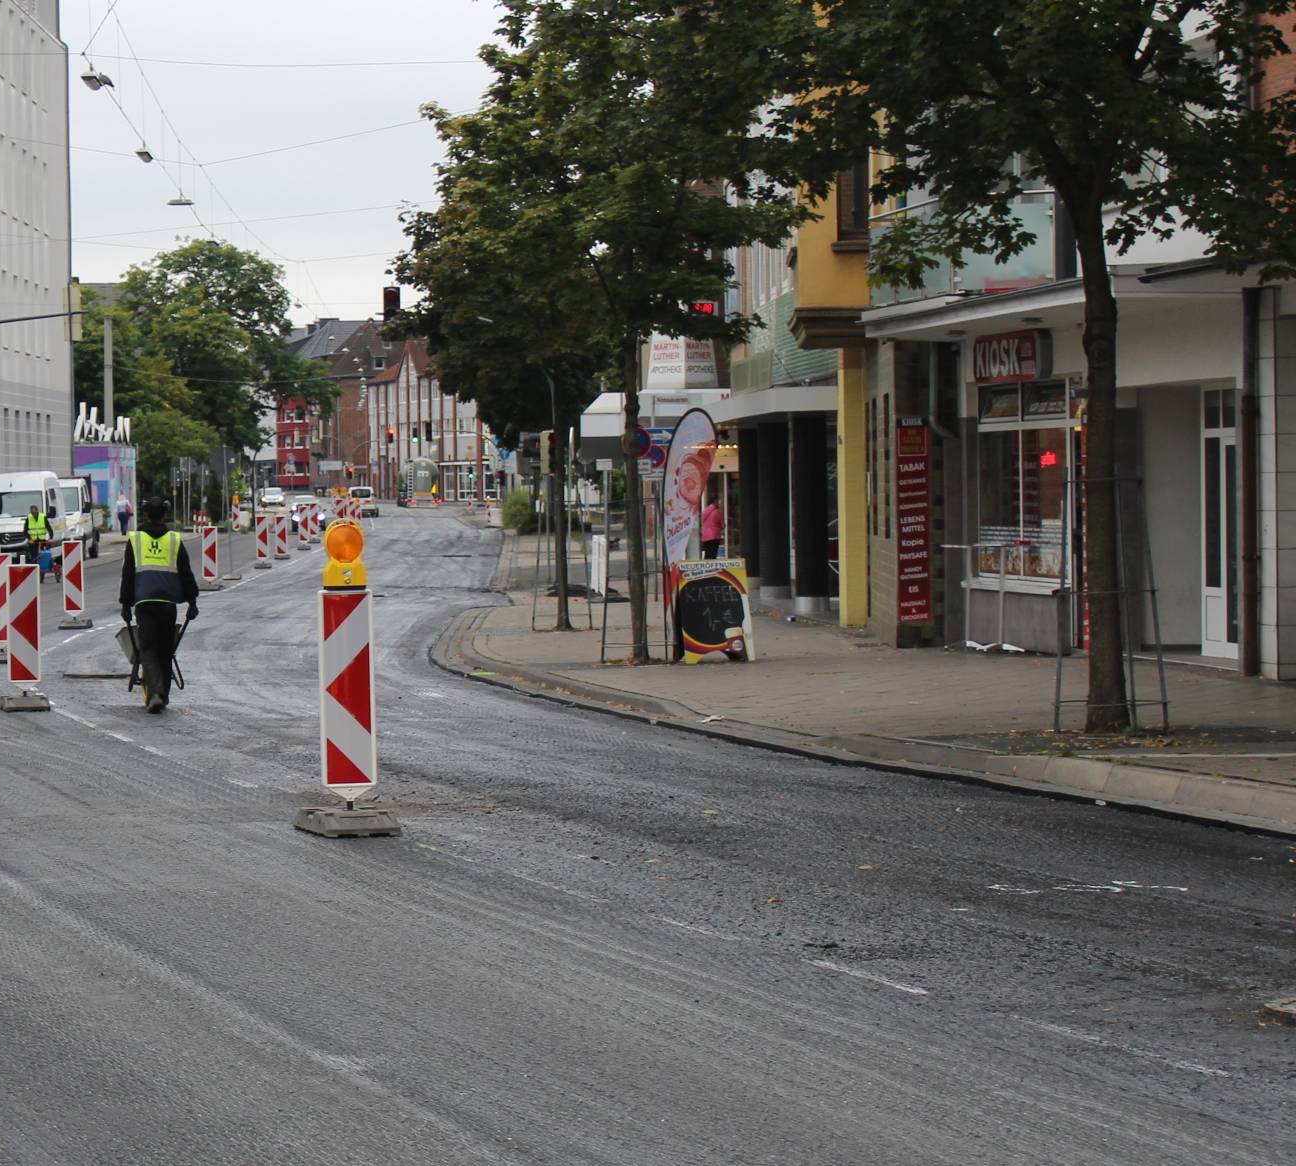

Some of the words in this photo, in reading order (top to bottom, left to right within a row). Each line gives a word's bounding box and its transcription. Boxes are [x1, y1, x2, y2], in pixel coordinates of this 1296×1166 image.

[653, 352, 680, 361] LUTHER
[686, 351, 712, 360] LUTHER
[976, 338, 1020, 378] KIOSK
[650, 366, 682, 374] APOTHEKE
[898, 462, 925, 472] TABAK
[900, 515, 926, 524] LEBENS
[902, 524, 926, 533] MITTEL
[902, 540, 924, 548] Kopie
[899, 551, 928, 560] PAYSAFE
[908, 585, 920, 593] EIS
[685, 585, 739, 603] KAFFEE
